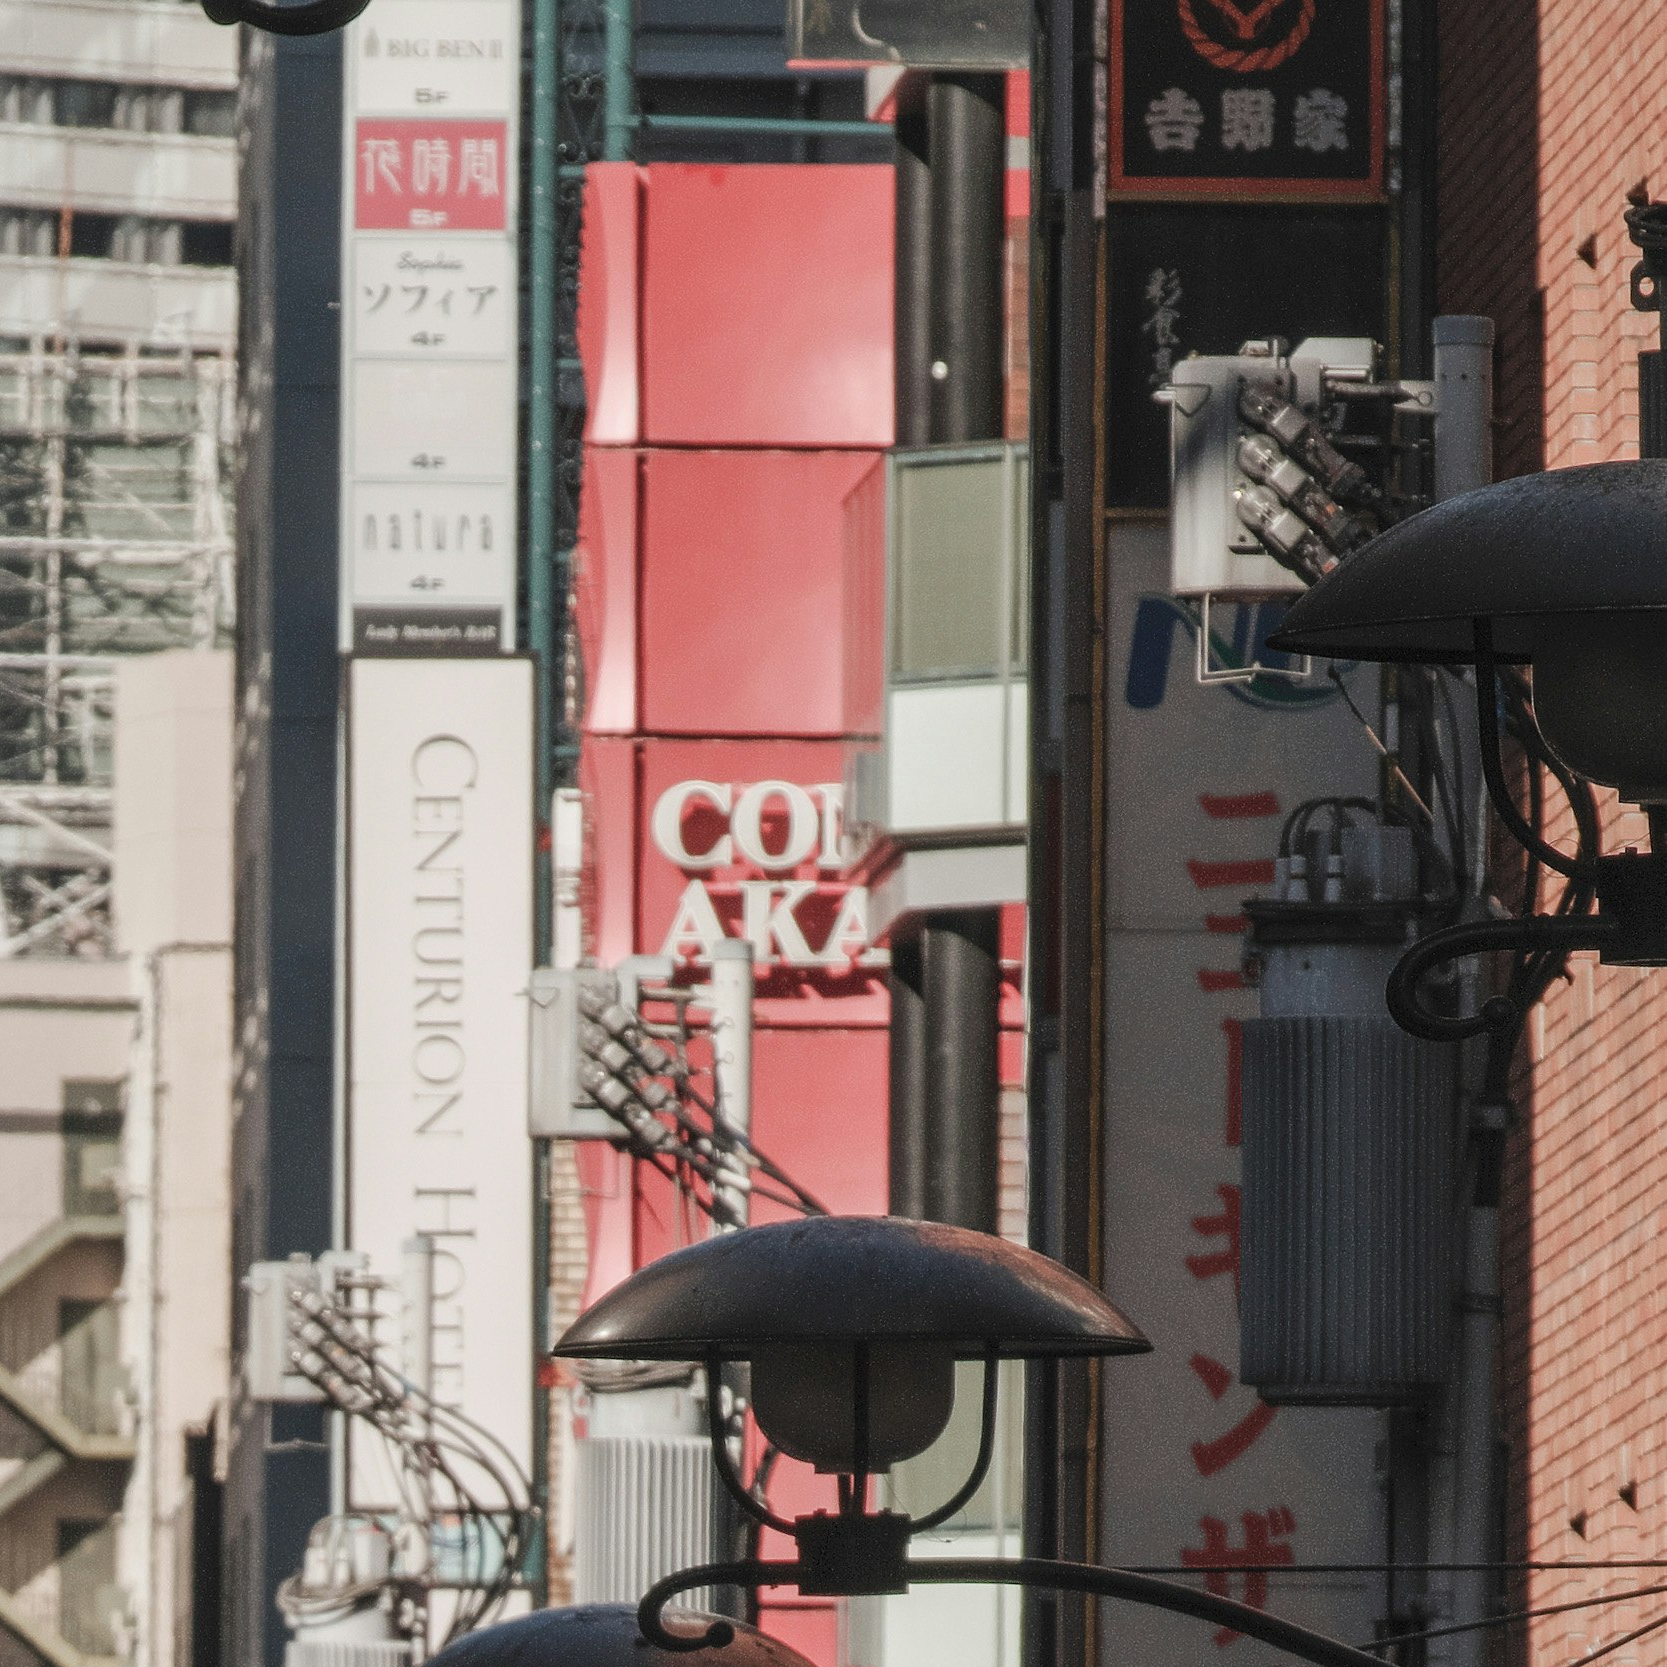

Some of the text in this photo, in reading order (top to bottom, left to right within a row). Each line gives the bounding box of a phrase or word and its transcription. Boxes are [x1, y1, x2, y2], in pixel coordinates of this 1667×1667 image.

[363, 283, 499, 316] ソフィア
[409, 733, 480, 1138] CENTURION
